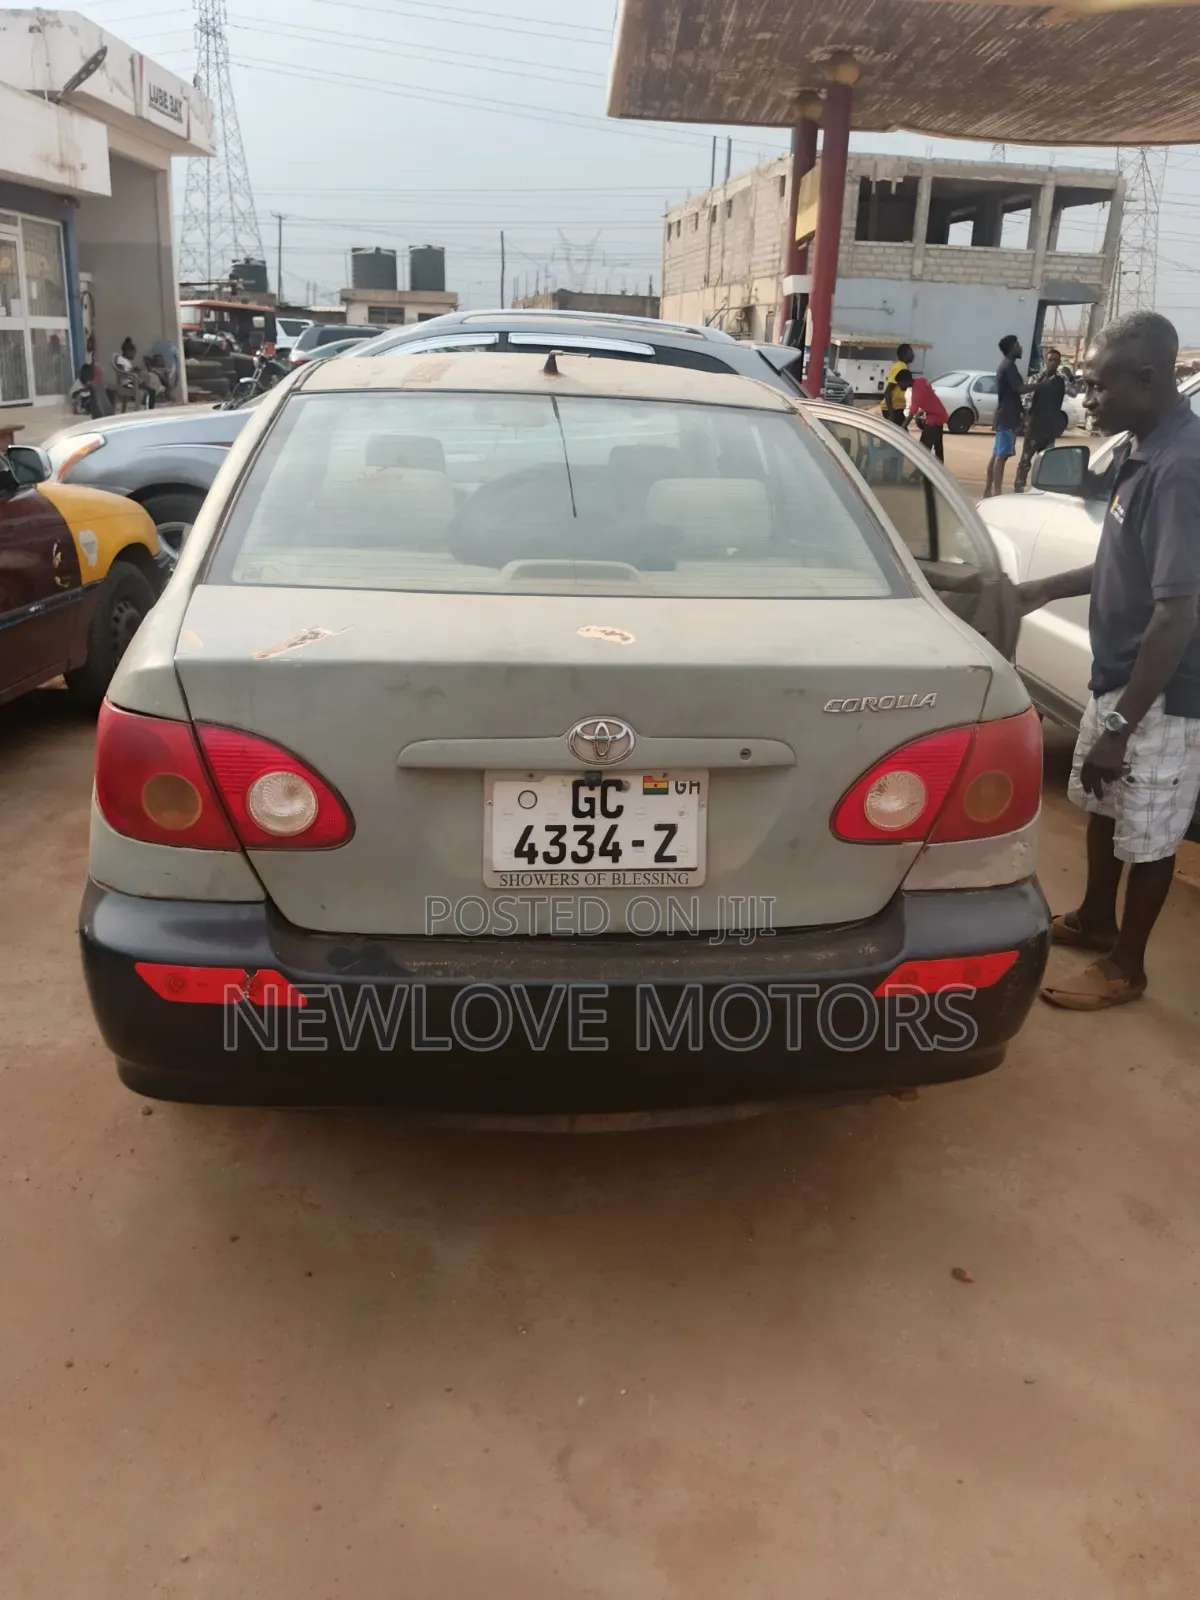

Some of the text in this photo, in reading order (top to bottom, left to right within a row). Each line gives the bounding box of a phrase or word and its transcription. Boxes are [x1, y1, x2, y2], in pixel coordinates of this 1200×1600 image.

[148, 82, 183, 119] LUBE BAY
[823, 692, 938, 713] COROLLA
[571, 779, 625, 819] GC
[674, 780, 700, 795] GH
[514, 823, 679, 865] 4334-Z
[500, 872, 689, 887] SHOWERS OF BLESSING
